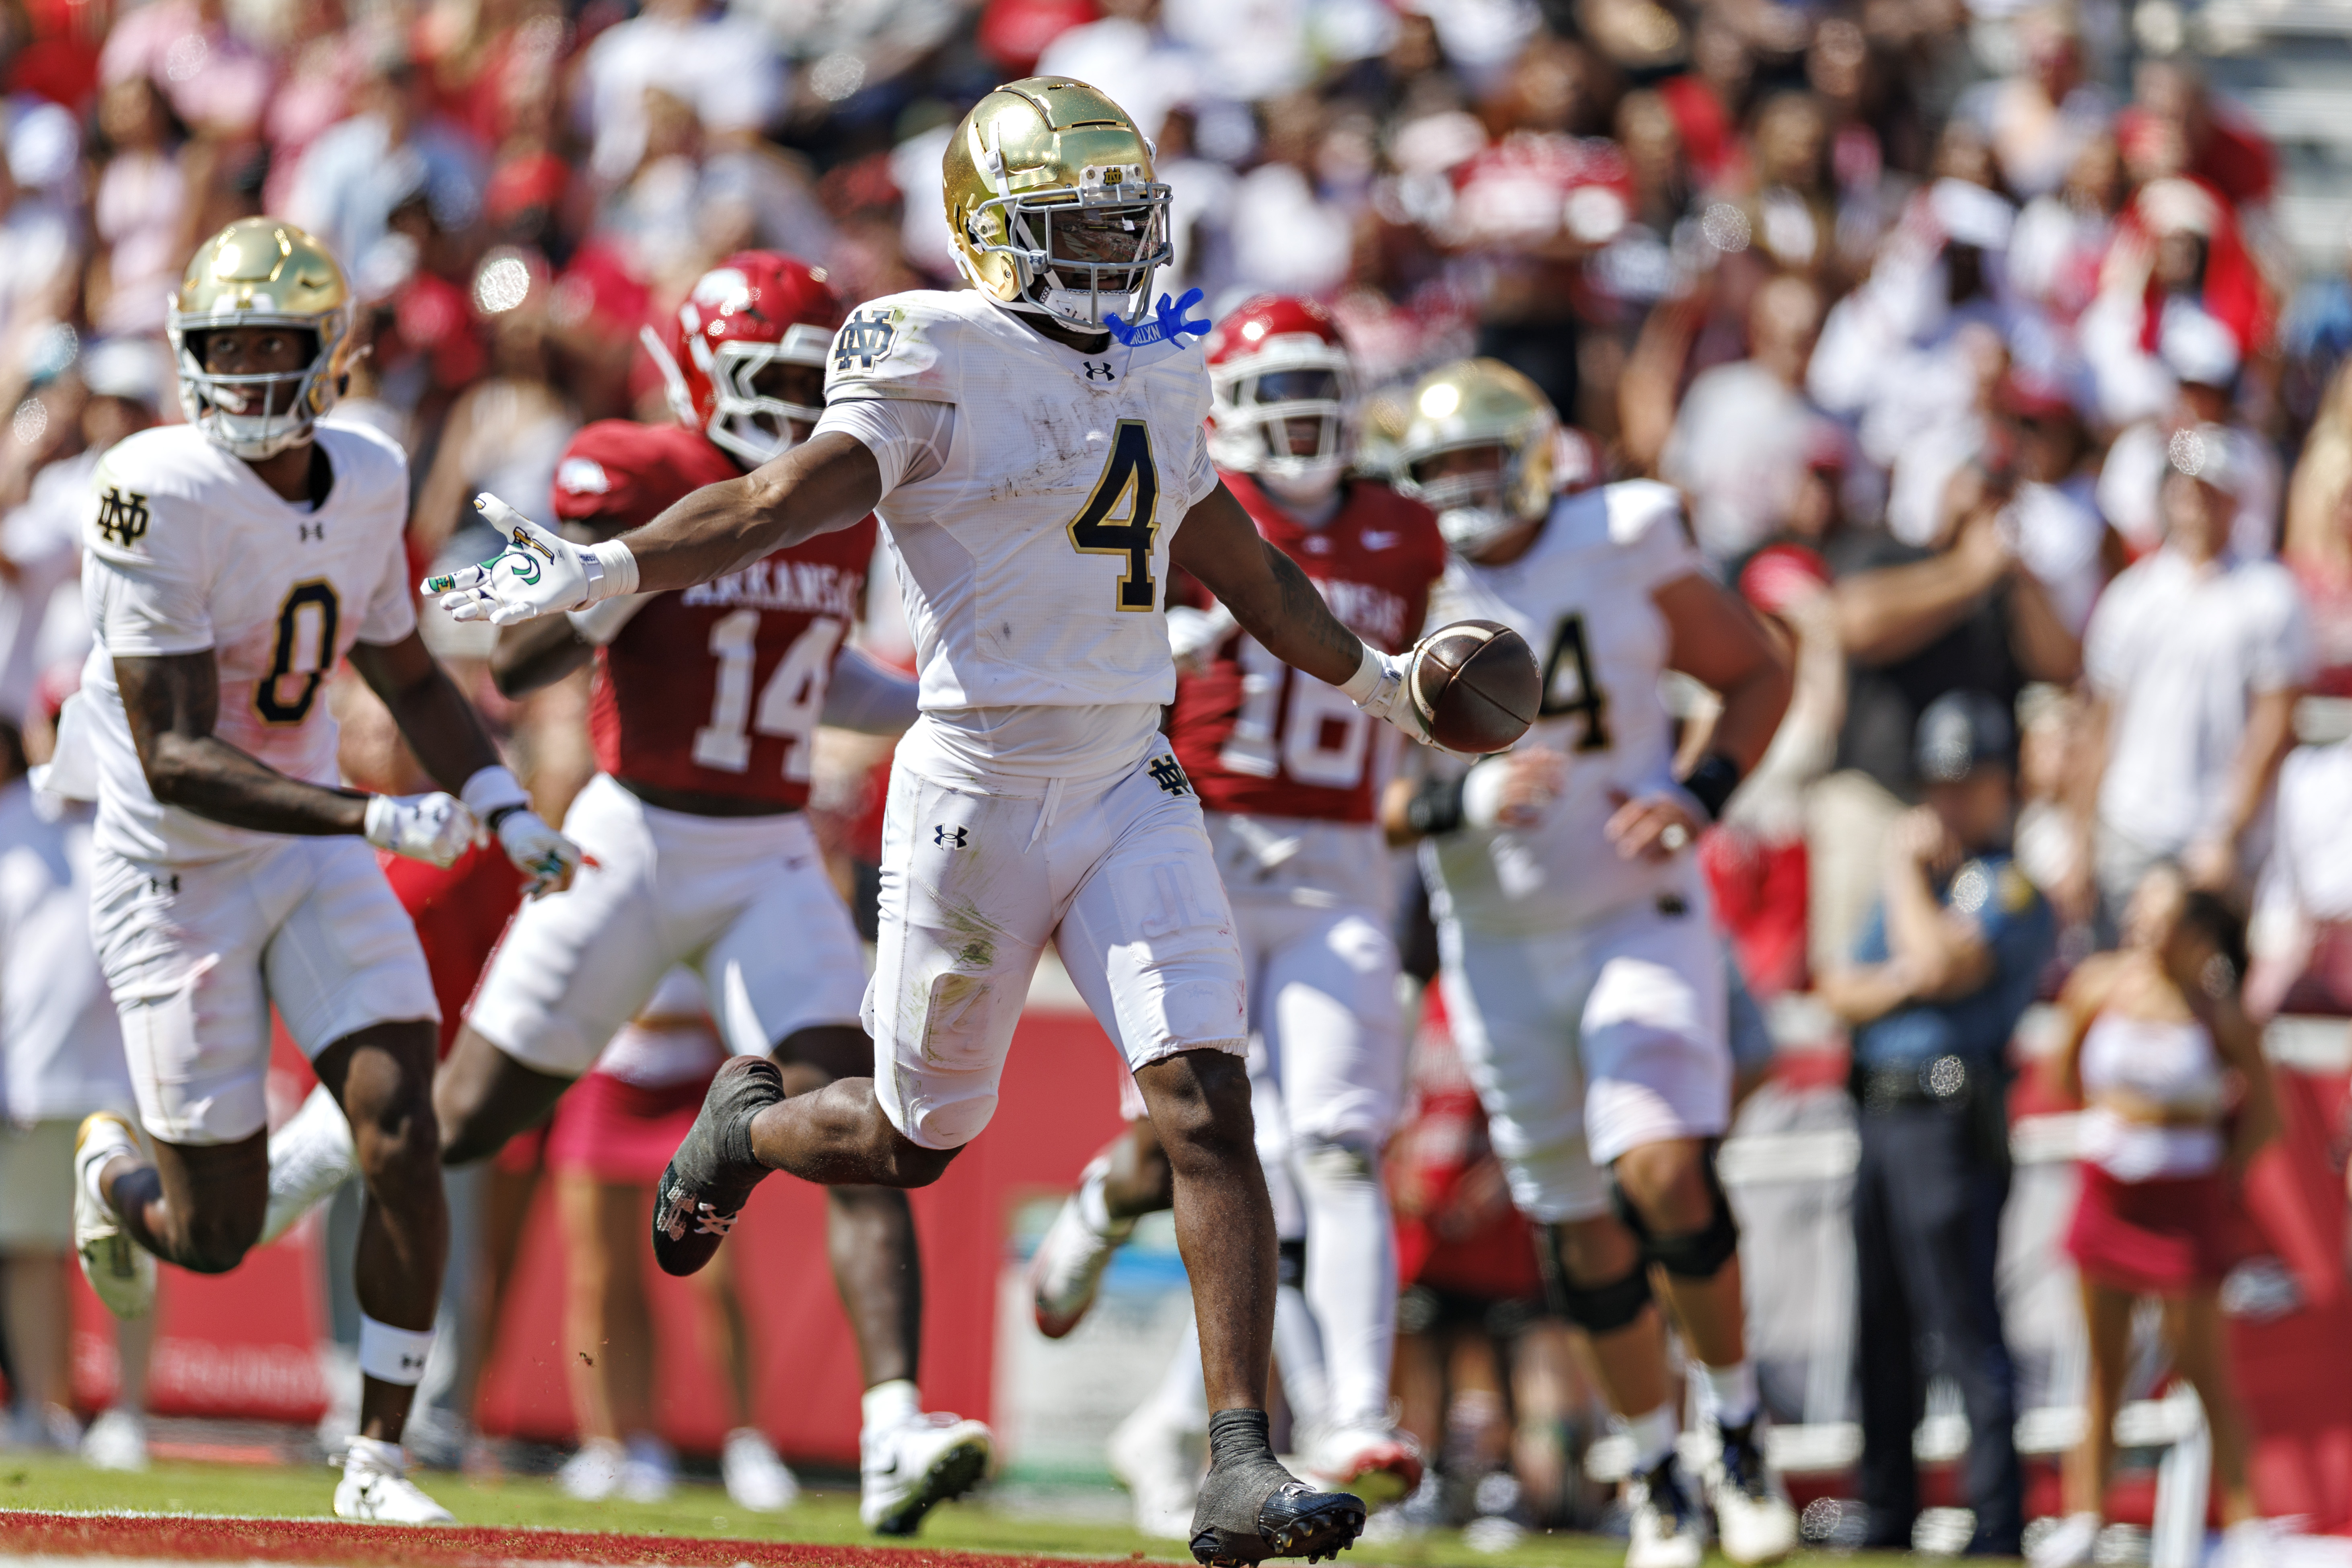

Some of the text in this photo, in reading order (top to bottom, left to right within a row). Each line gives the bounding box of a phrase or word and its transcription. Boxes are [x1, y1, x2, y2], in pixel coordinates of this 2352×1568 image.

[1066, 419, 1160, 612] 4
[254, 576, 341, 727] 0
[691, 607, 841, 783] 14
